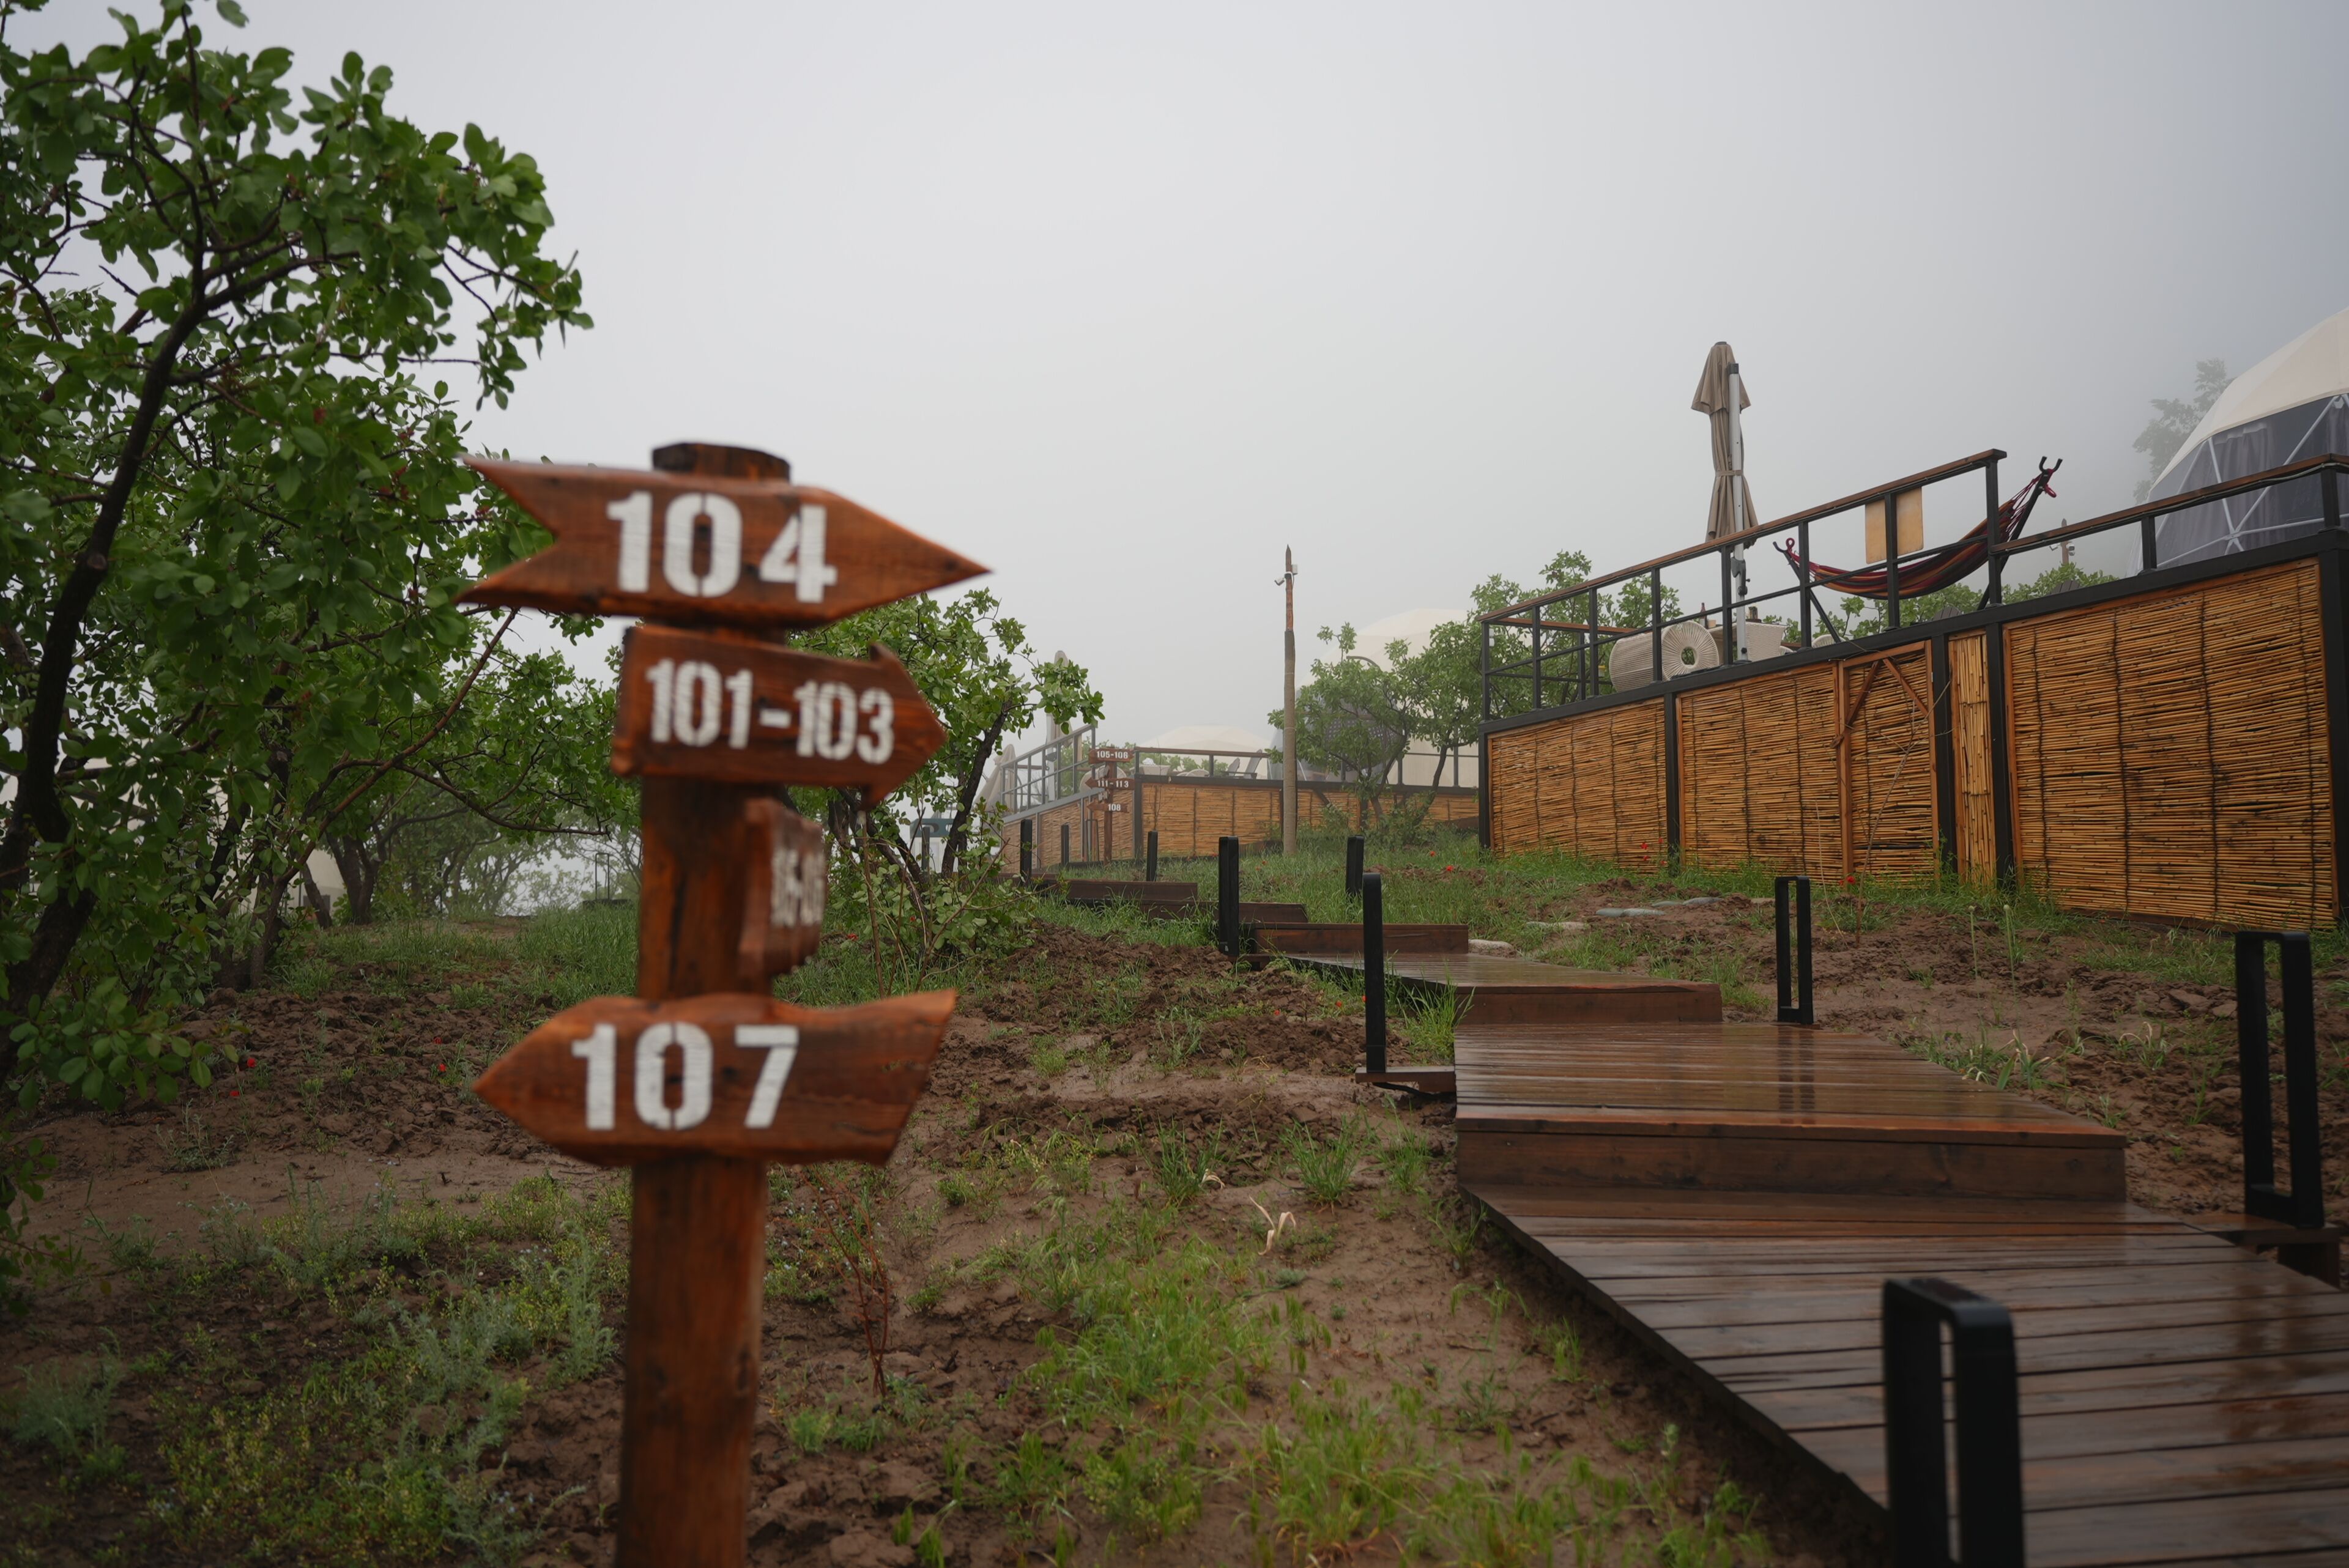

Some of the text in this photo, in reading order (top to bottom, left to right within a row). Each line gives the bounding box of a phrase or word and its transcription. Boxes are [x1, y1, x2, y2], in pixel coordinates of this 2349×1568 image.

[606, 490, 837, 603] 104
[645, 658, 895, 765] 101-103
[1097, 750, 1128, 759] 105-106
[571, 1021, 800, 1131] 107
